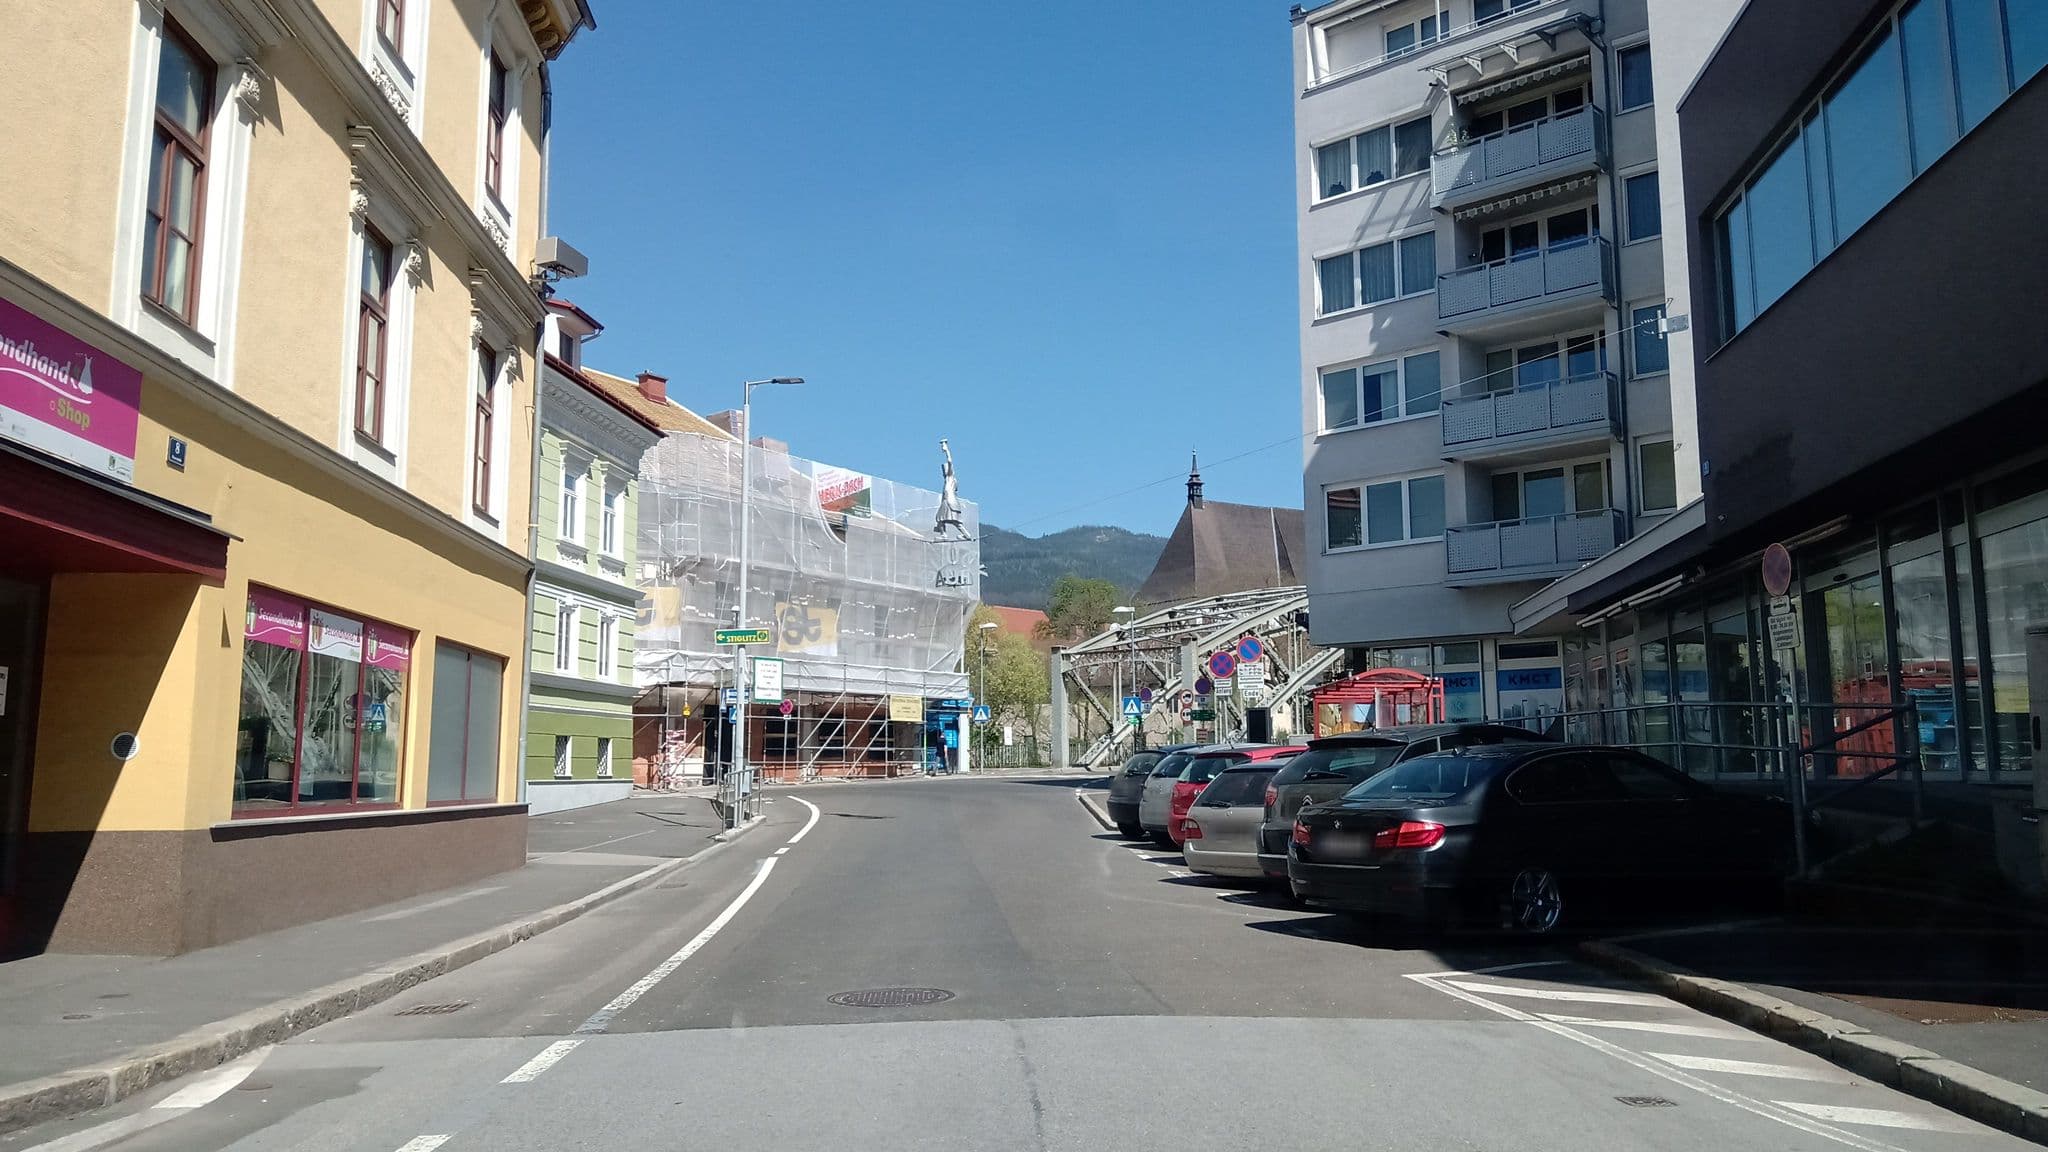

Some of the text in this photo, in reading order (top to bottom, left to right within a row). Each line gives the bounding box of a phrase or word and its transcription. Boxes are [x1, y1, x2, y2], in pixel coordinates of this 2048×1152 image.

[57, 399, 90, 431] Shop
[174, 442, 181, 454] 8
[726, 634, 757, 643] STIGLITZ
[1444, 675, 1475, 688] KMCT
[1508, 672, 1552, 686] KMCT
